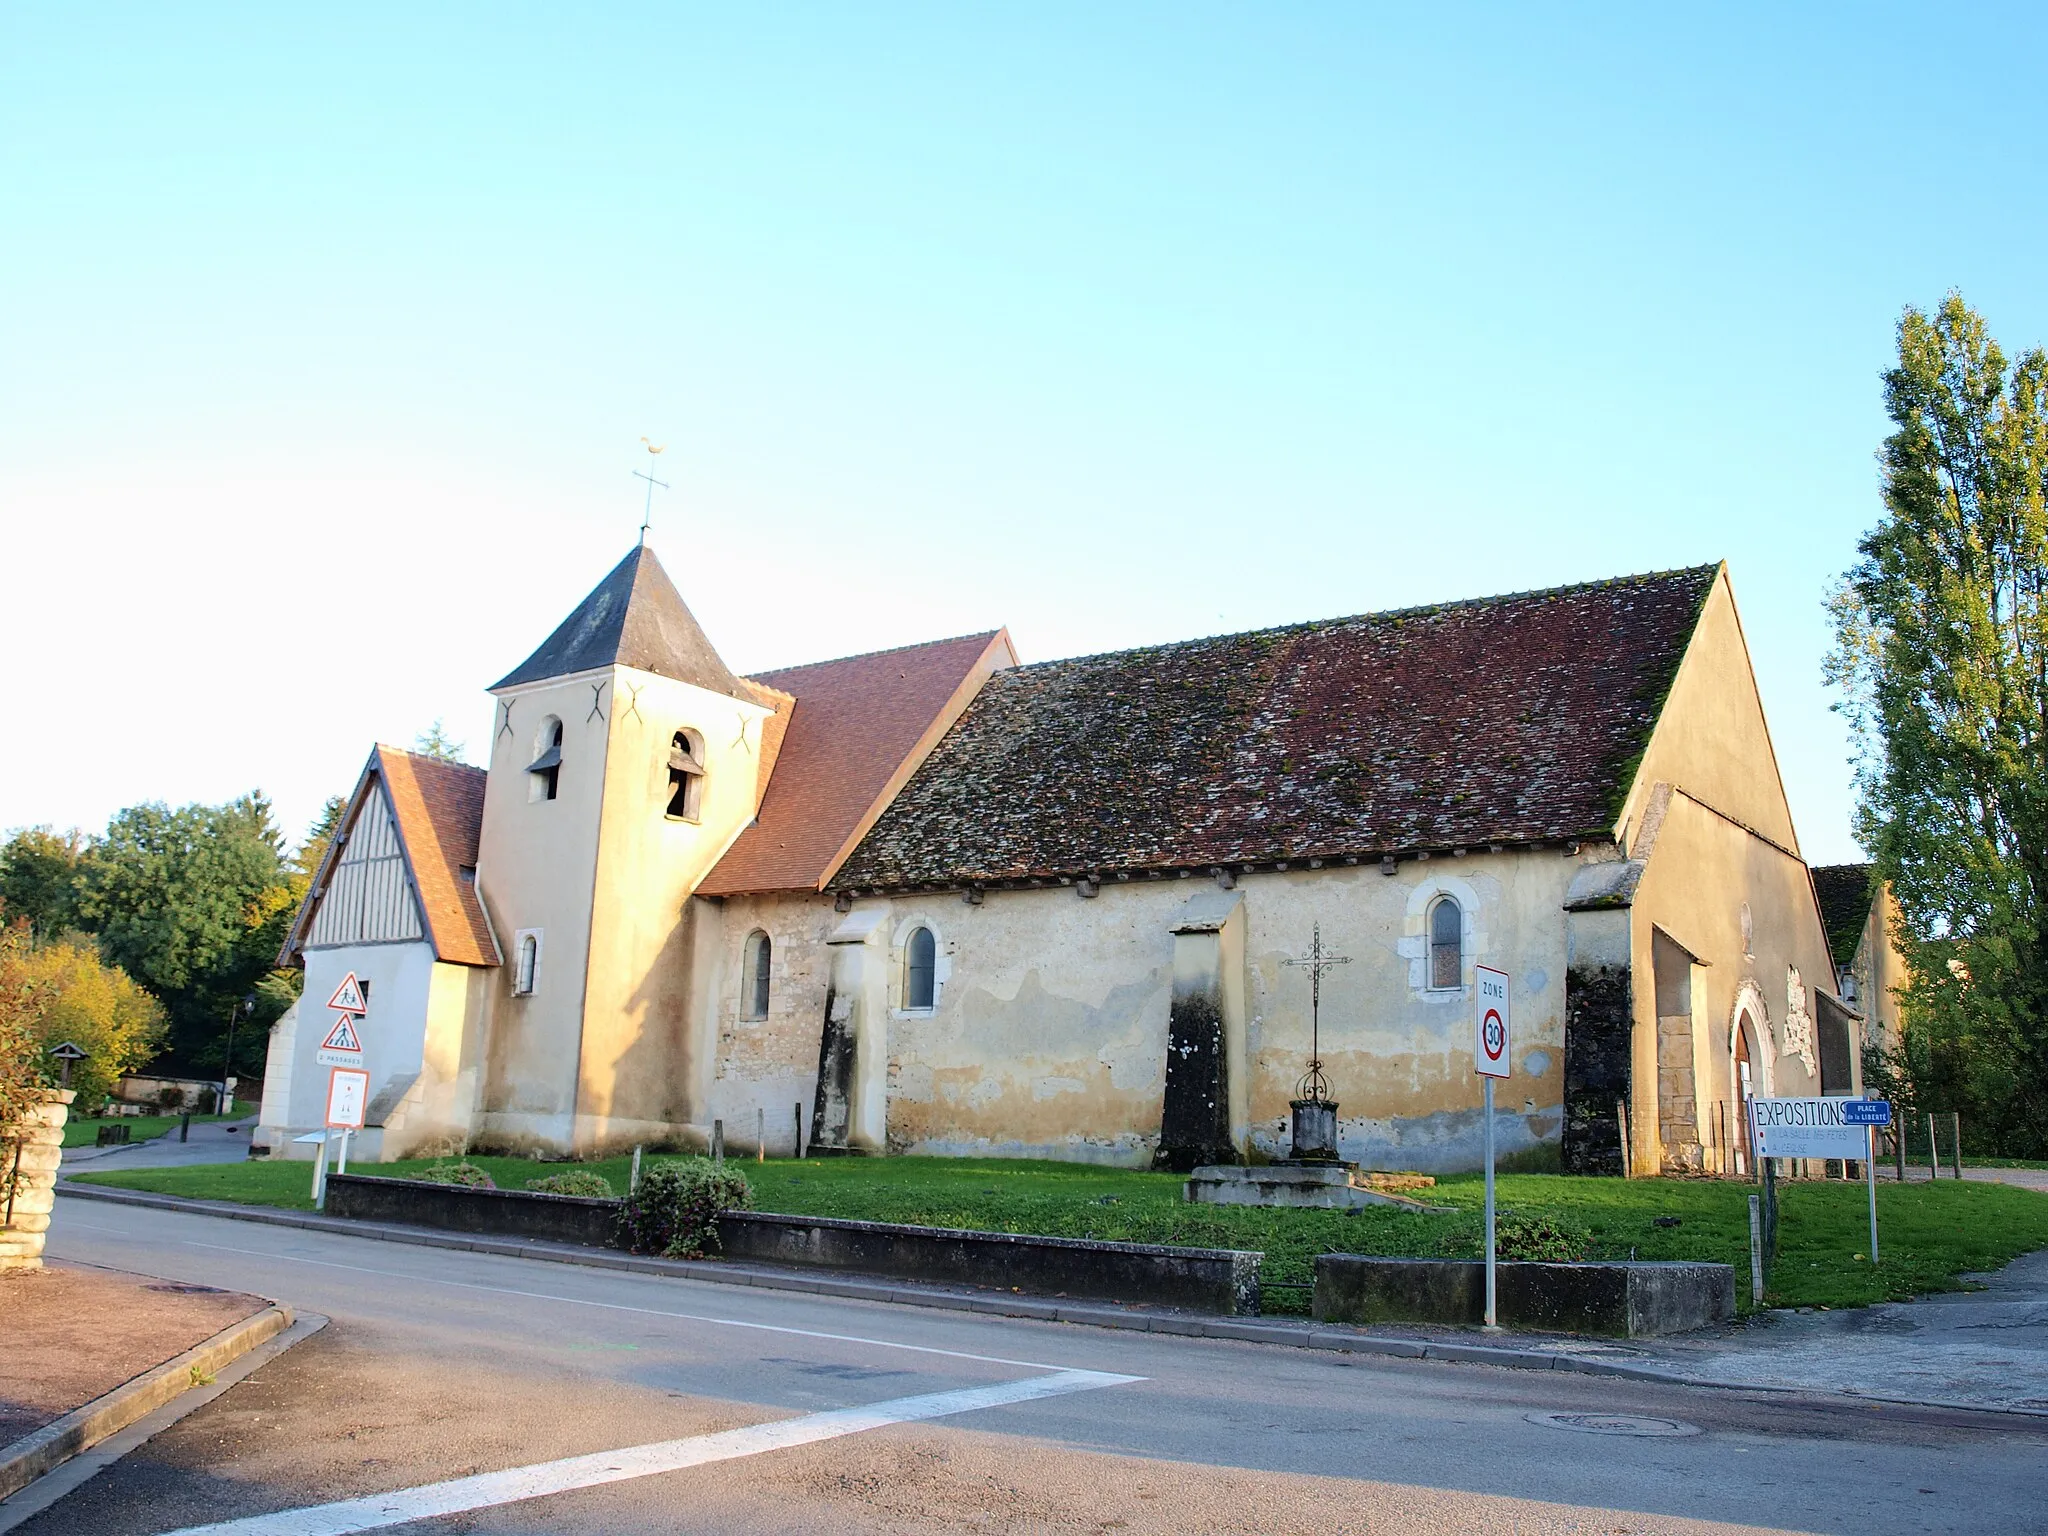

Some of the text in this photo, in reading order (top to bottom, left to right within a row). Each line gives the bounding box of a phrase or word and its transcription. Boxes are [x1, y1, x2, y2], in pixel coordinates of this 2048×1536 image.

[1483, 981, 1503, 999] ZONE
[1487, 1023, 1500, 1046] 30
[1861, 1113, 1887, 1121] LIBERTÉ
[1780, 1130, 1789, 1138] LA
[1790, 1130, 1811, 1139] SALLE
